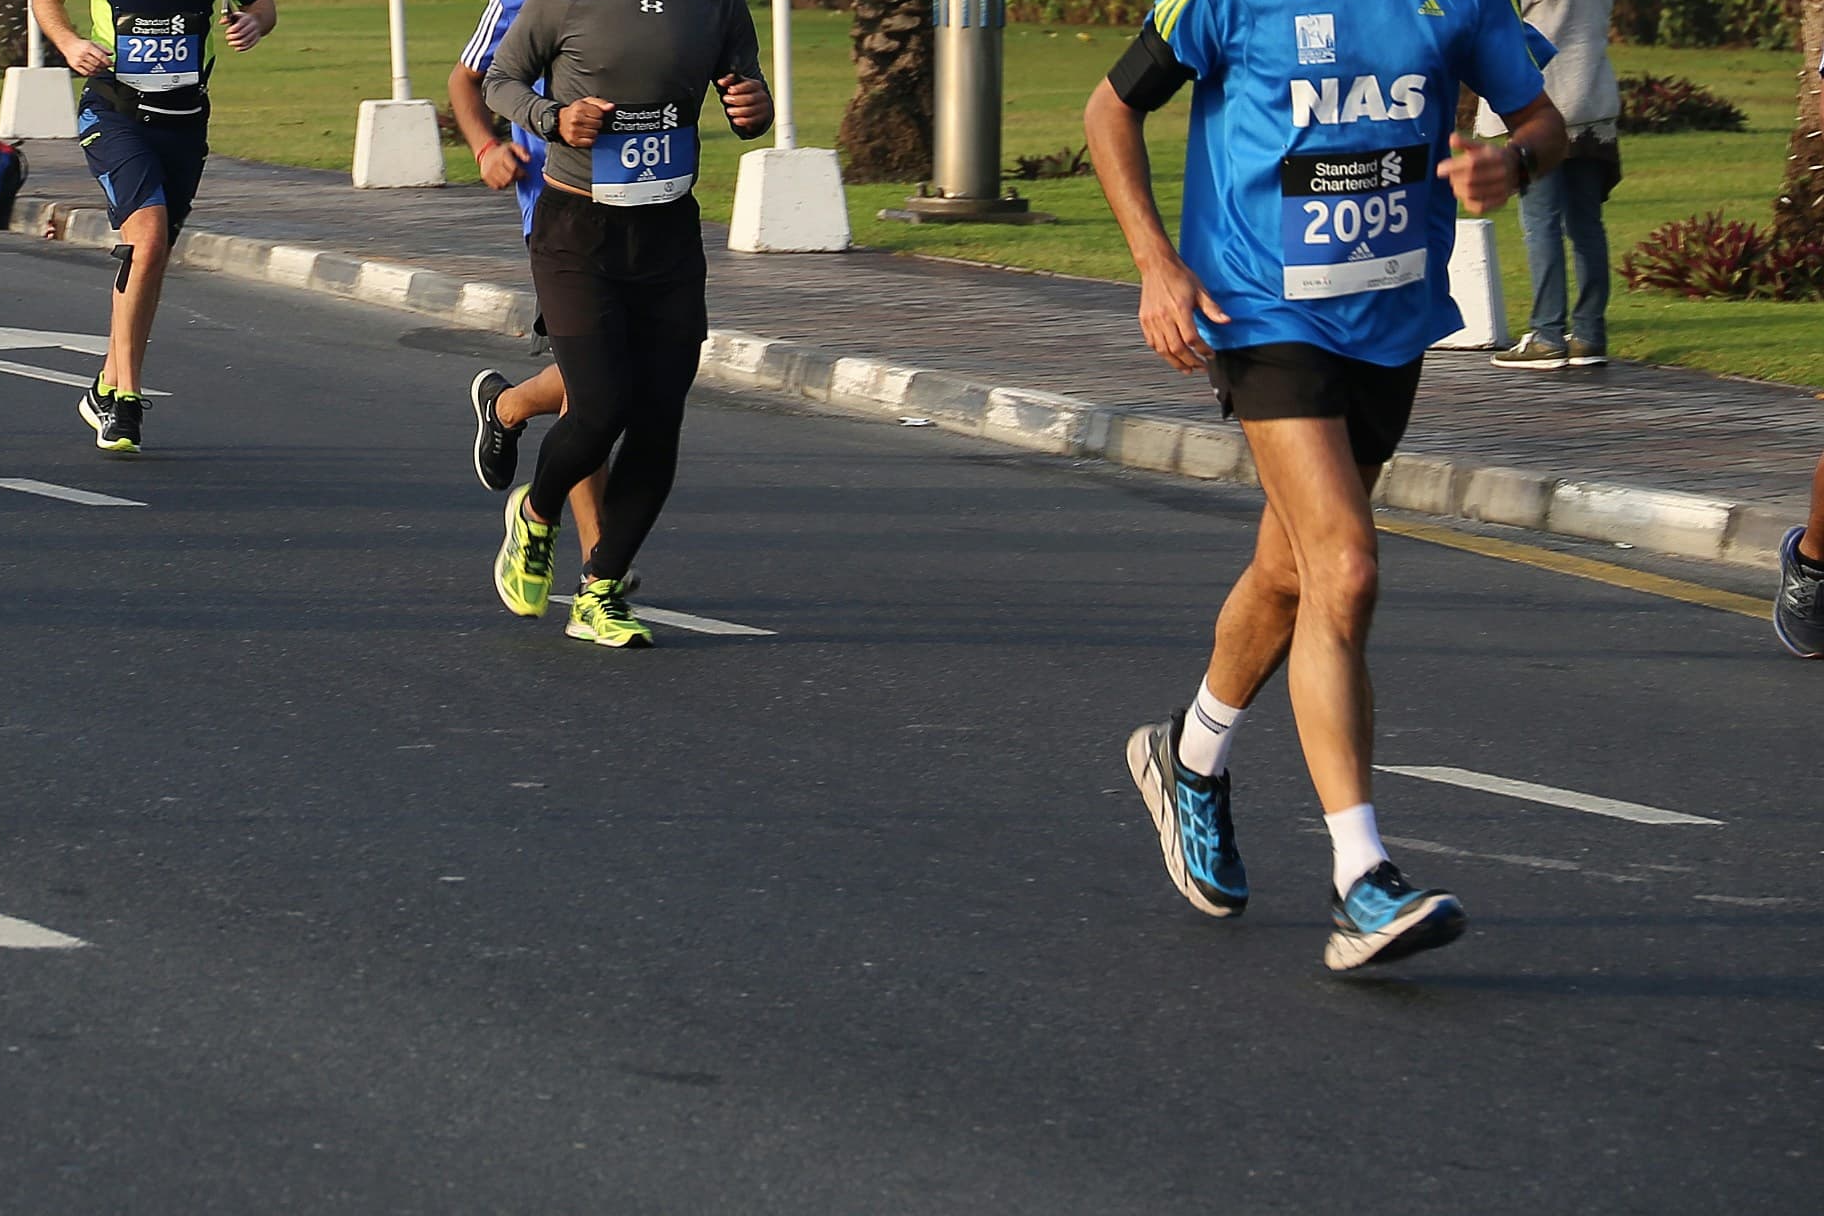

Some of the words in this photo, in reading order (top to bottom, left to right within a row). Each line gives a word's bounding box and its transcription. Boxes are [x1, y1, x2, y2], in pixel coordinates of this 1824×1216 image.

[134, 16, 171, 27] Standard
[127, 37, 189, 64] 2256
[1289, 73, 1428, 128] NAS
[614, 108, 661, 121] Standard
[611, 120, 661, 132] Chartered
[620, 133, 671, 169] 681
[1314, 158, 1378, 178] Standard
[1309, 174, 1378, 194] Chartered
[1302, 189, 1410, 246] 2095
